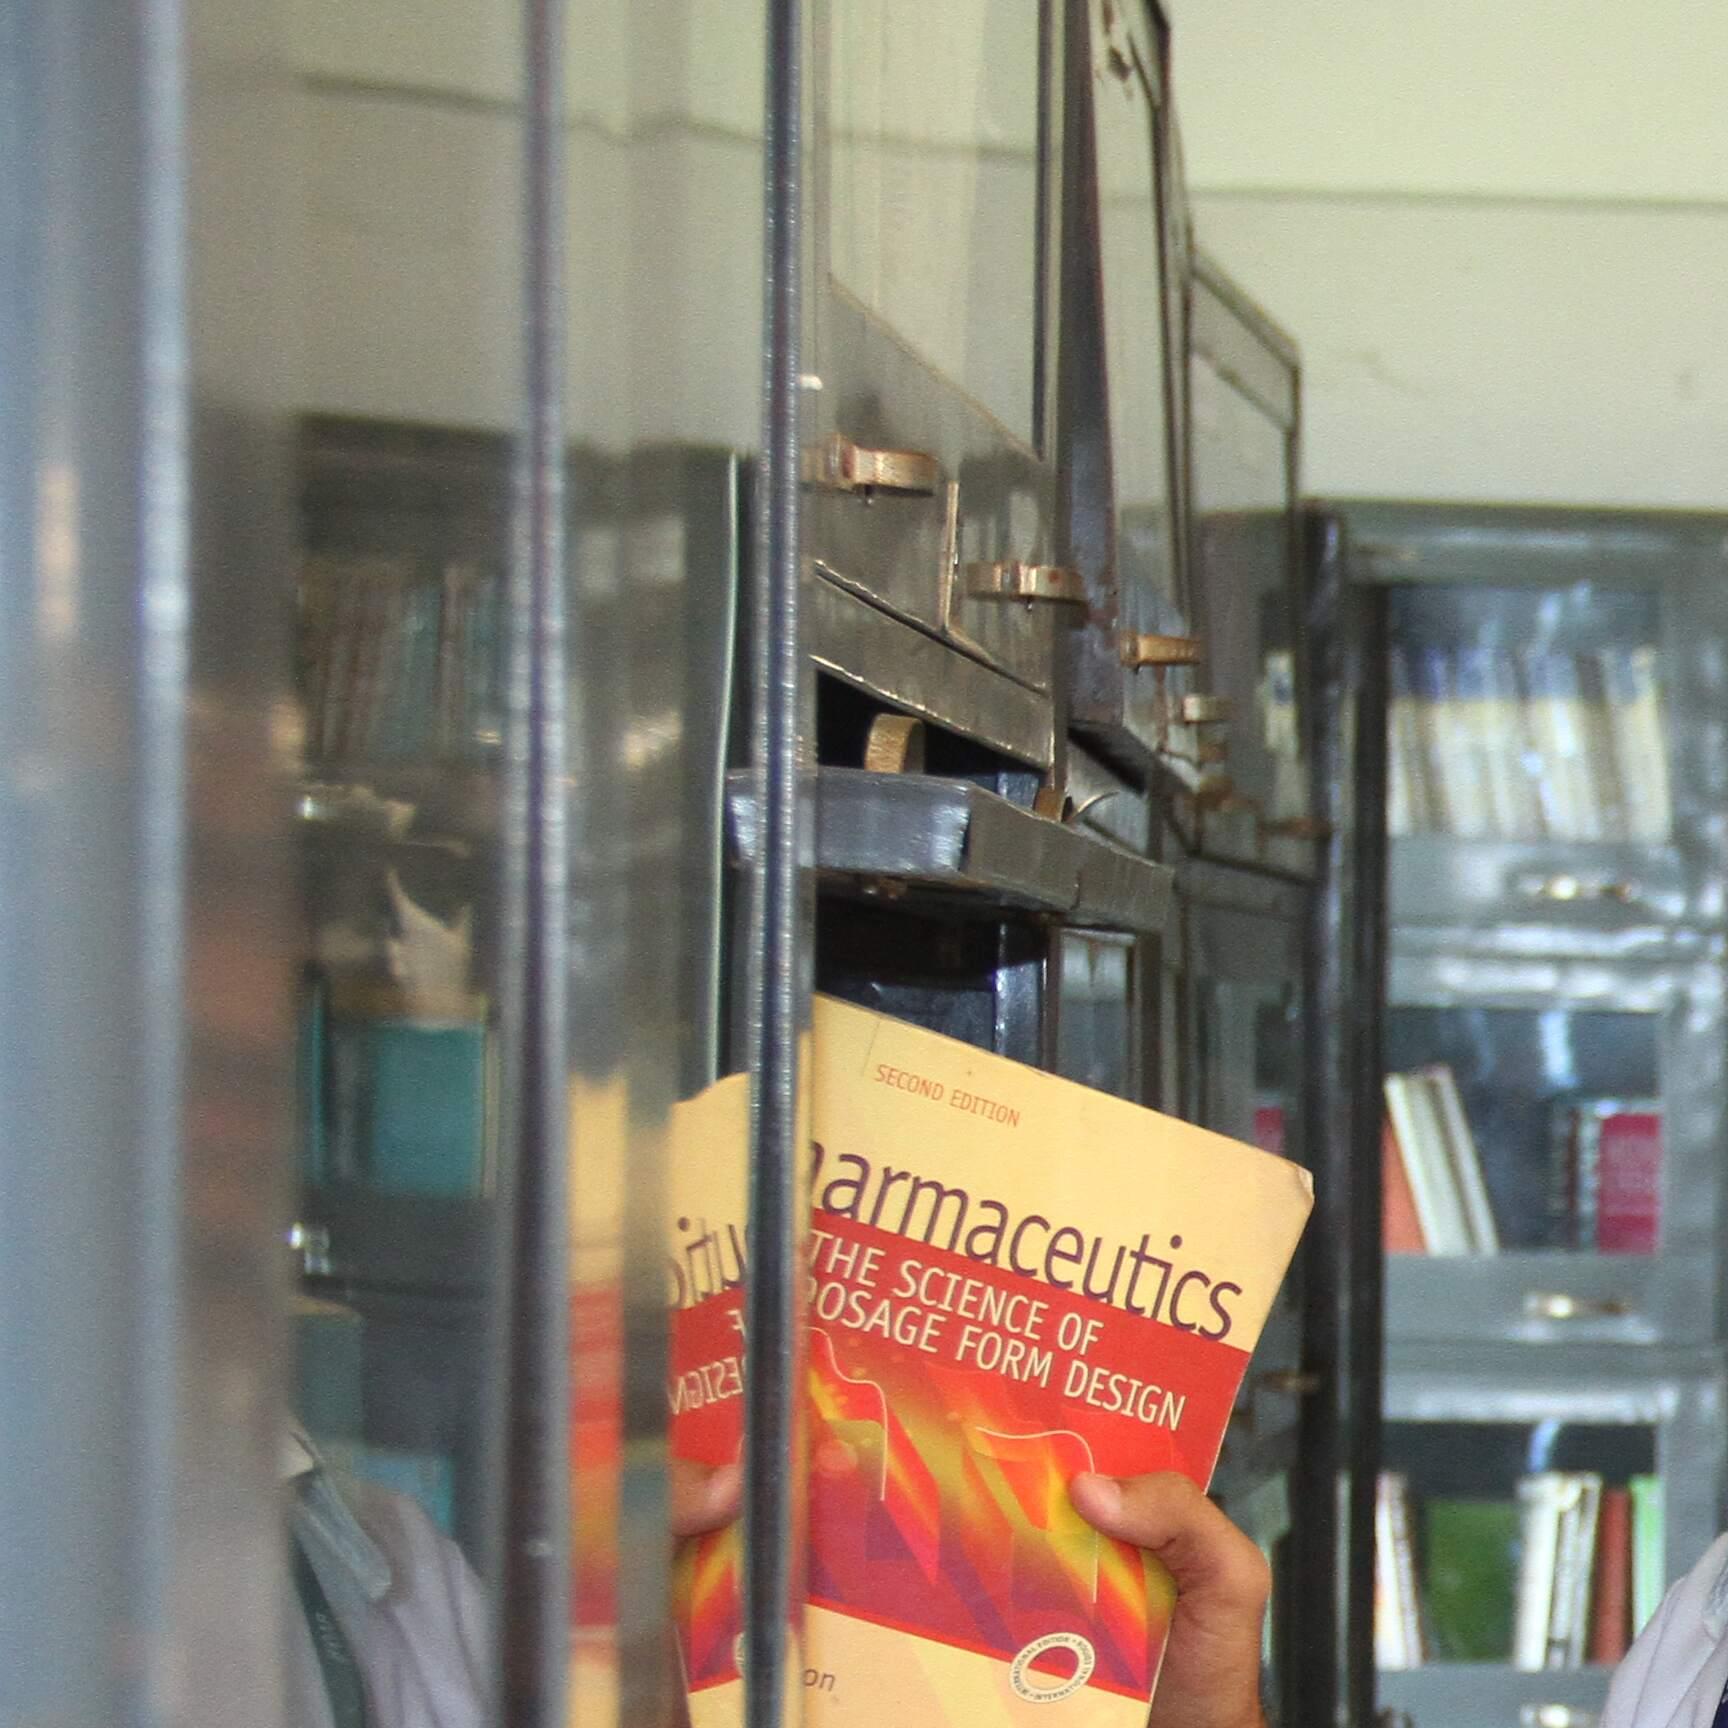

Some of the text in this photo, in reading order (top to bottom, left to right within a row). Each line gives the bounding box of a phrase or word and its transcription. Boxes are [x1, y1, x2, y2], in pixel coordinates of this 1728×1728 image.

[875, 1064, 1020, 1127] SECOND EDITION
[811, 1228, 886, 1288] THE
[892, 1259, 1049, 1341] SCIENCE
[1057, 1312, 1104, 1355] OF
[955, 1324, 1053, 1388] FORM
[1063, 1359, 1186, 1431] DESIGN
